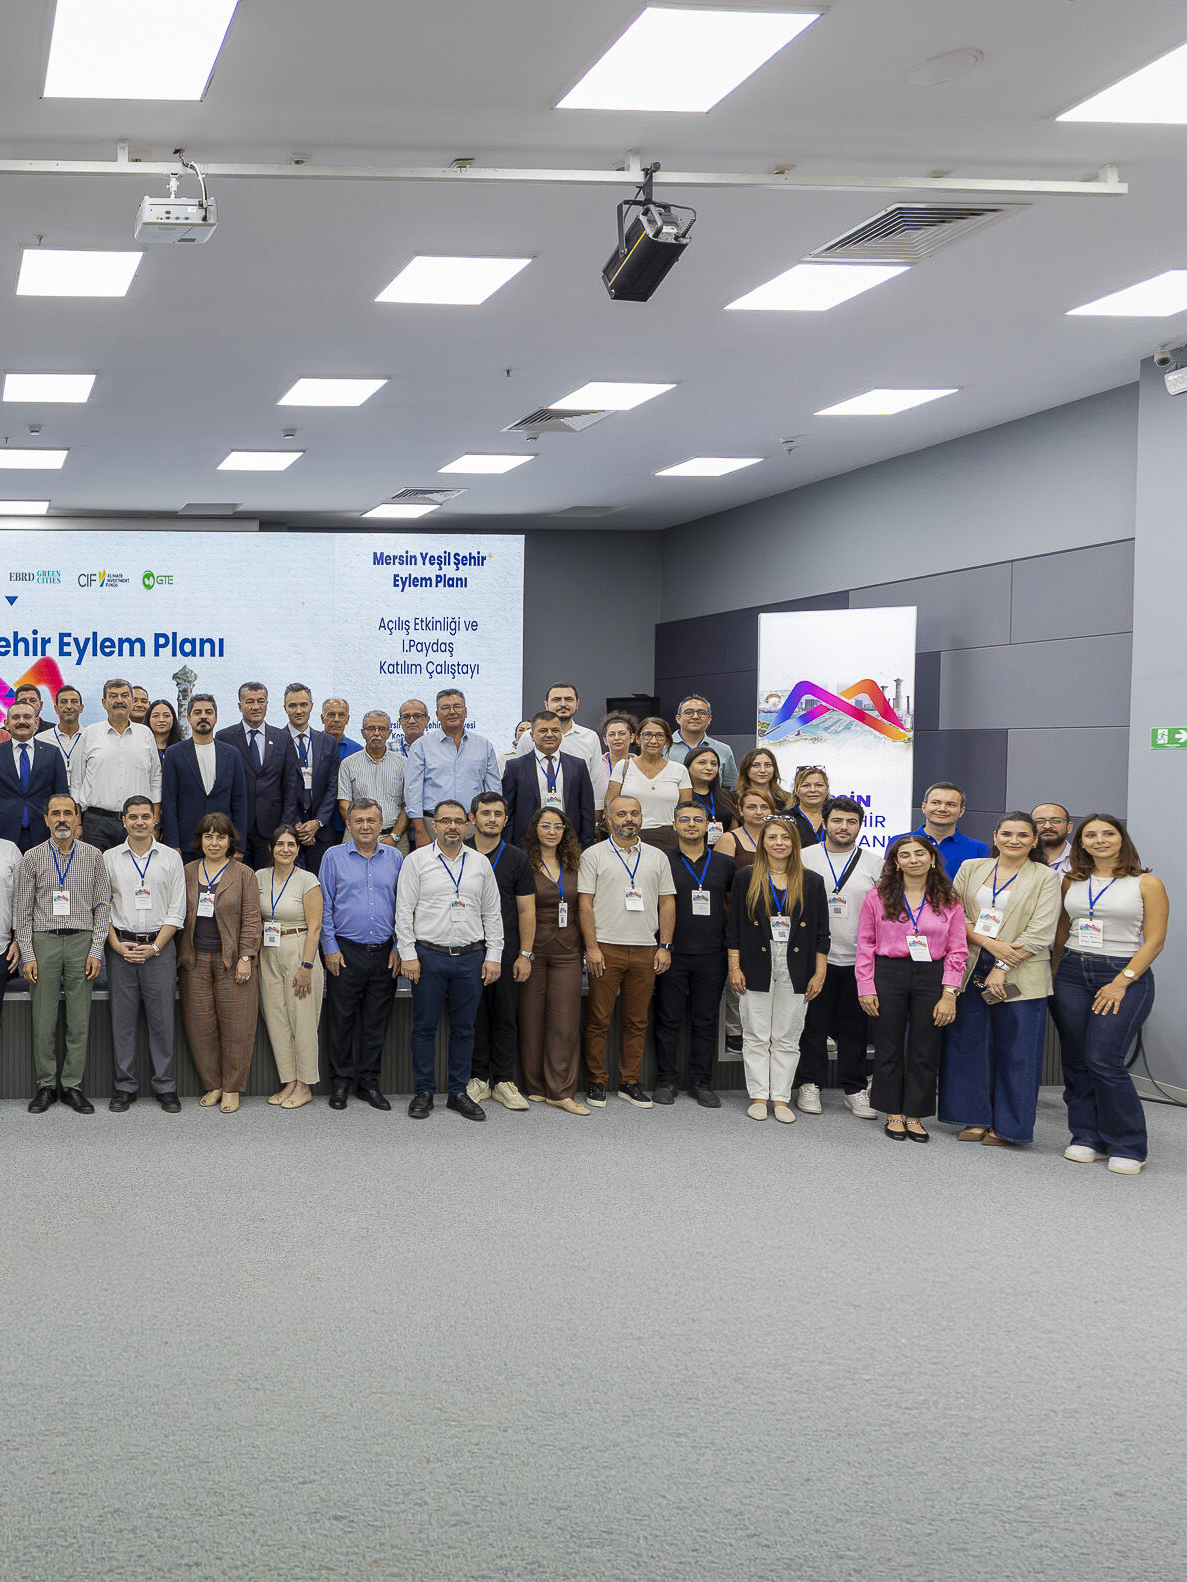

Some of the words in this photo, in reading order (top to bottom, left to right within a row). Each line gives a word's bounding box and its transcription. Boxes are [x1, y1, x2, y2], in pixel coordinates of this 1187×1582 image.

[372, 550, 417, 566] Mersin
[420, 550, 451, 571] Yeşil
[453, 551, 487, 571] Şehir
[9, 572, 35, 582] EBRD
[78, 573, 97, 588] CIF
[156, 575, 174, 585] GTE
[393, 574, 433, 592] Eylem
[435, 574, 468, 588] Planı
[378, 617, 411, 635] Açılış
[413, 617, 461, 636] Etkinliği
[463, 620, 479, 632] ve
[58, 632, 146, 665] Eylem
[154, 632, 224, 658] Planı
[402, 639, 454, 657] I.Paydaş
[379, 660, 422, 675] Katılım
[426, 660, 480, 679] Çalıştayı
